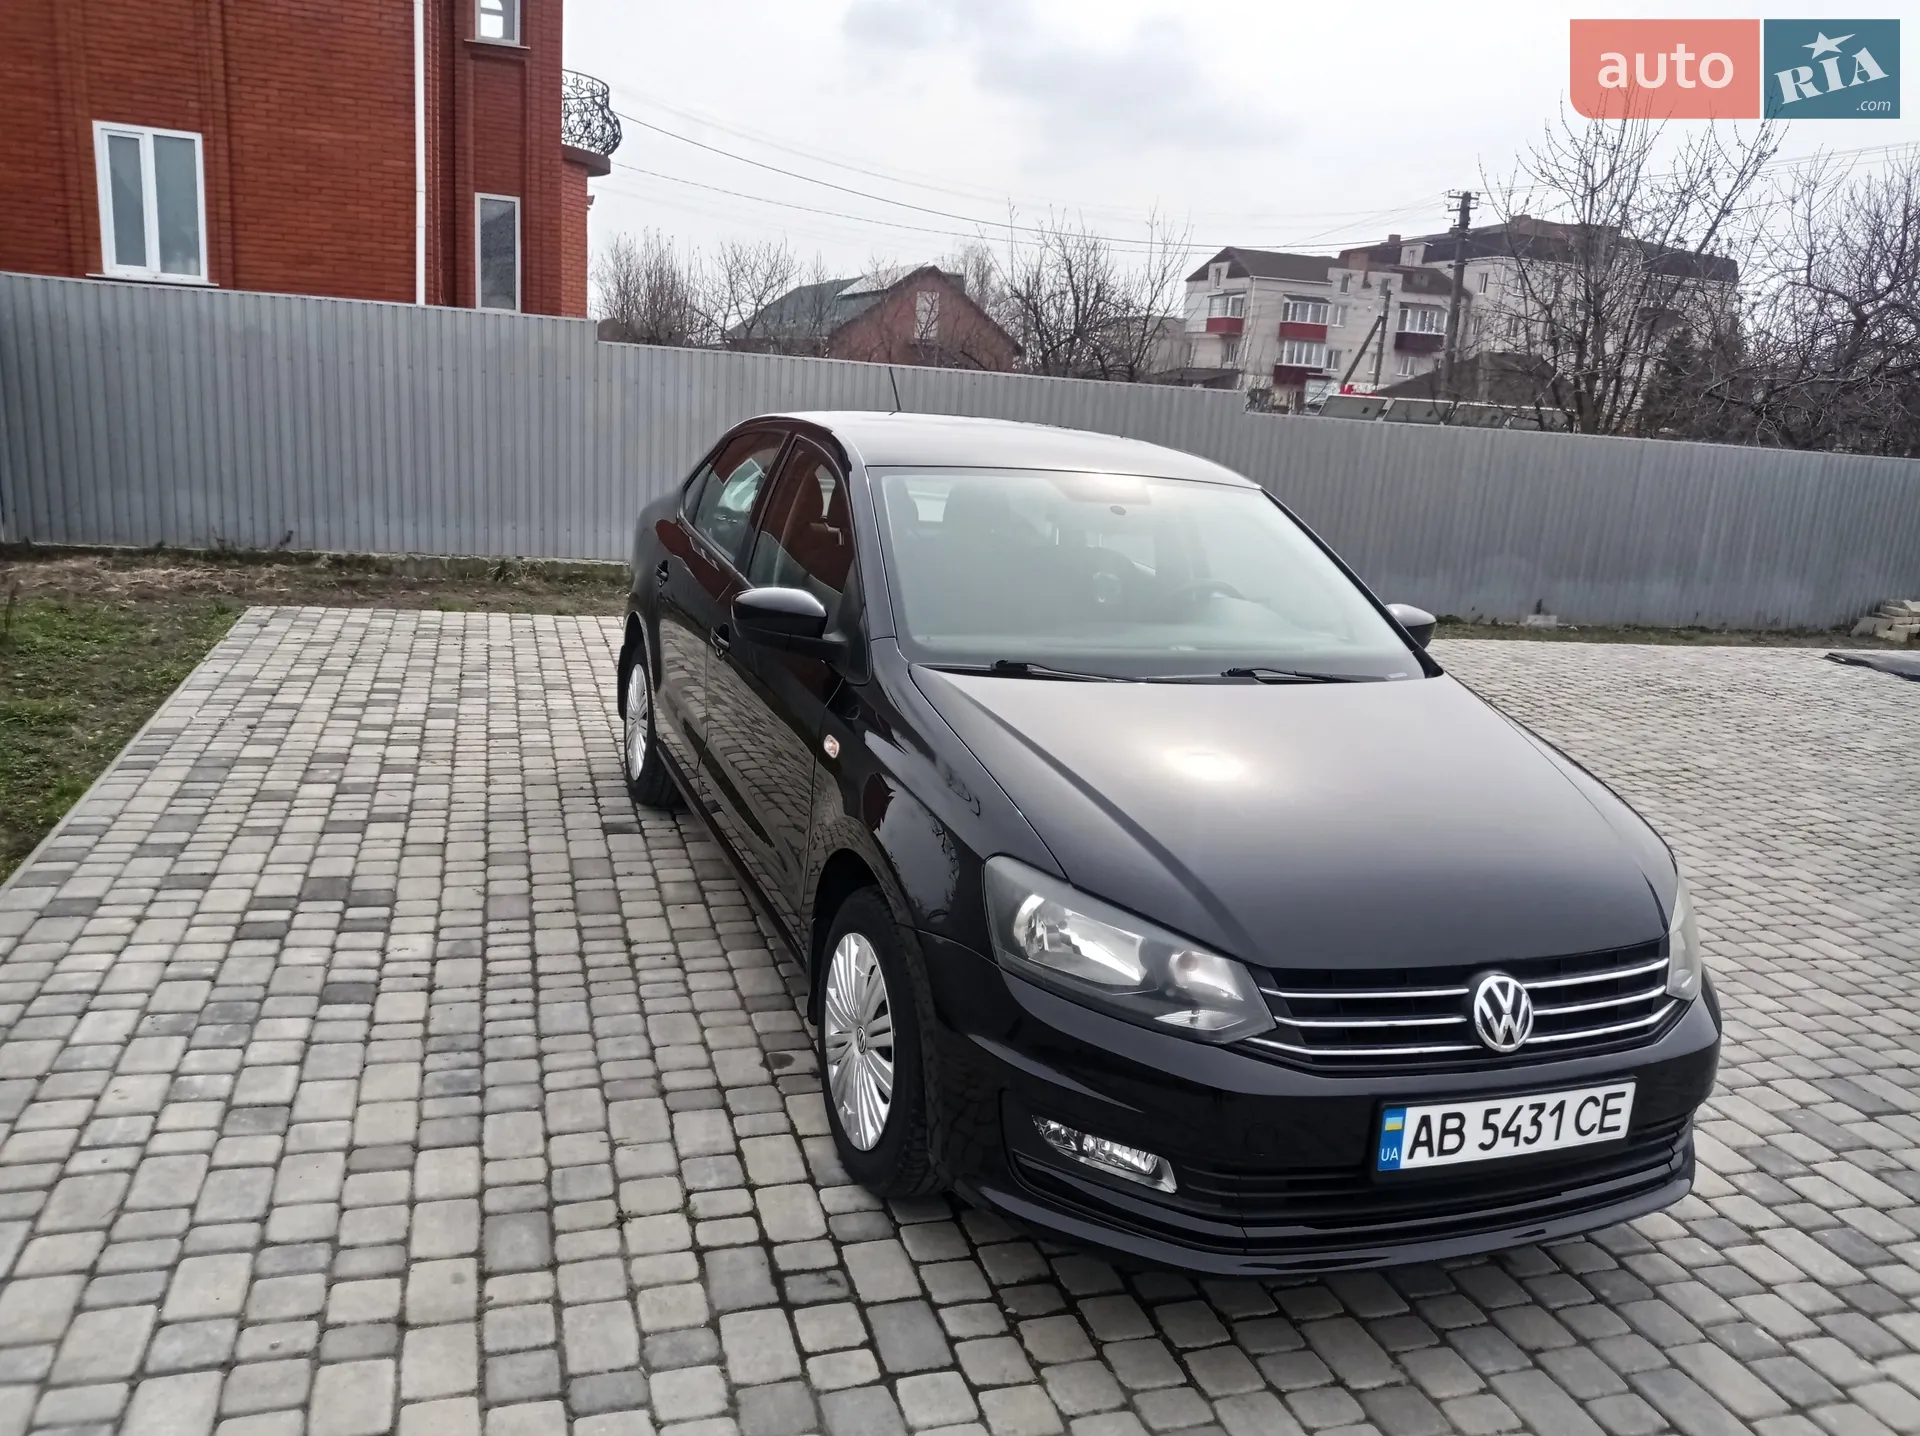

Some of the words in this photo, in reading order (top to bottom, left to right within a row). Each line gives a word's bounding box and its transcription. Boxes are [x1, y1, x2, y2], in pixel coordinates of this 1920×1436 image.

[1407, 1112, 1466, 1160] AB
[1478, 1100, 1566, 1151] 5431
[1574, 1091, 1627, 1136] CE
[1381, 1147, 1399, 1162] UA
